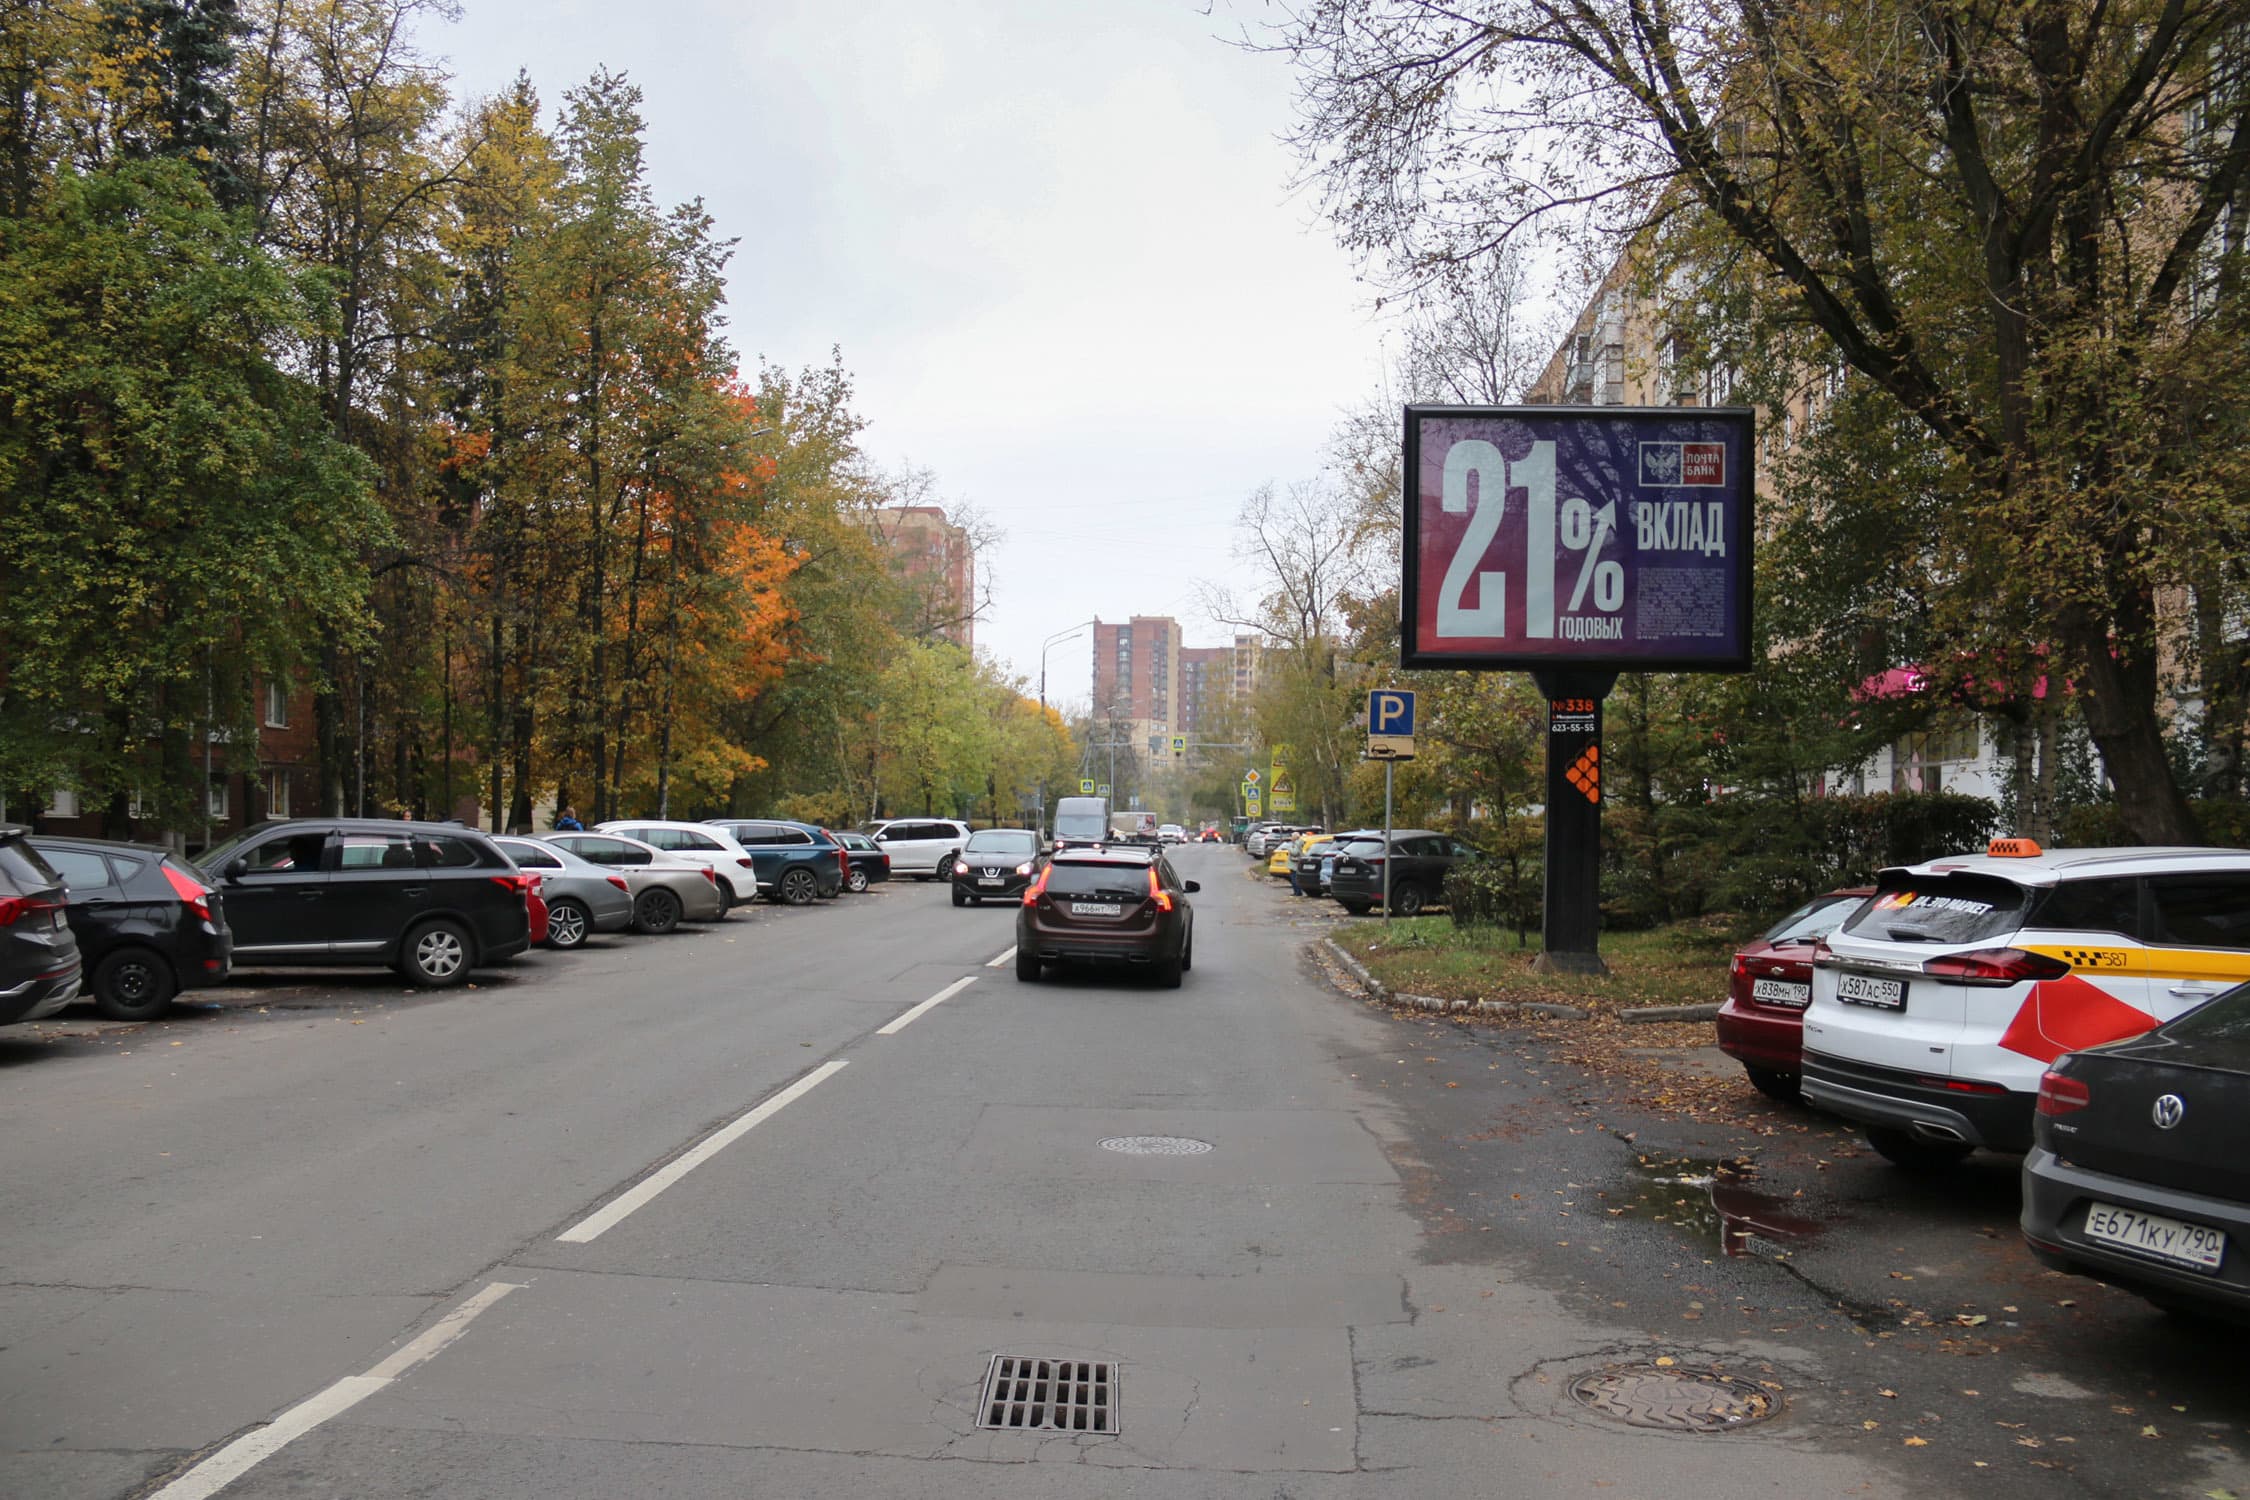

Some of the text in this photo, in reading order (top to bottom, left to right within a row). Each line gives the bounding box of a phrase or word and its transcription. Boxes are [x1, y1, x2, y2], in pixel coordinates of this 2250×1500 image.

[1686, 453, 1720, 465] ПОЧТА
[1686, 465, 1716, 476] БАНК
[1437, 439, 1624, 639] 21%
[1637, 502, 1726, 557] ВКЛАД
[1559, 616, 1623, 641] ГОДОВЫХ
[1379, 695, 1405, 731] P
[1552, 723, 1594, 732] 623-55-55
[2102, 952, 2127, 967] 587
[1842, 976, 1899, 999] Х587АС 550
[2092, 1210, 2218, 1252] Е671КУ 790
